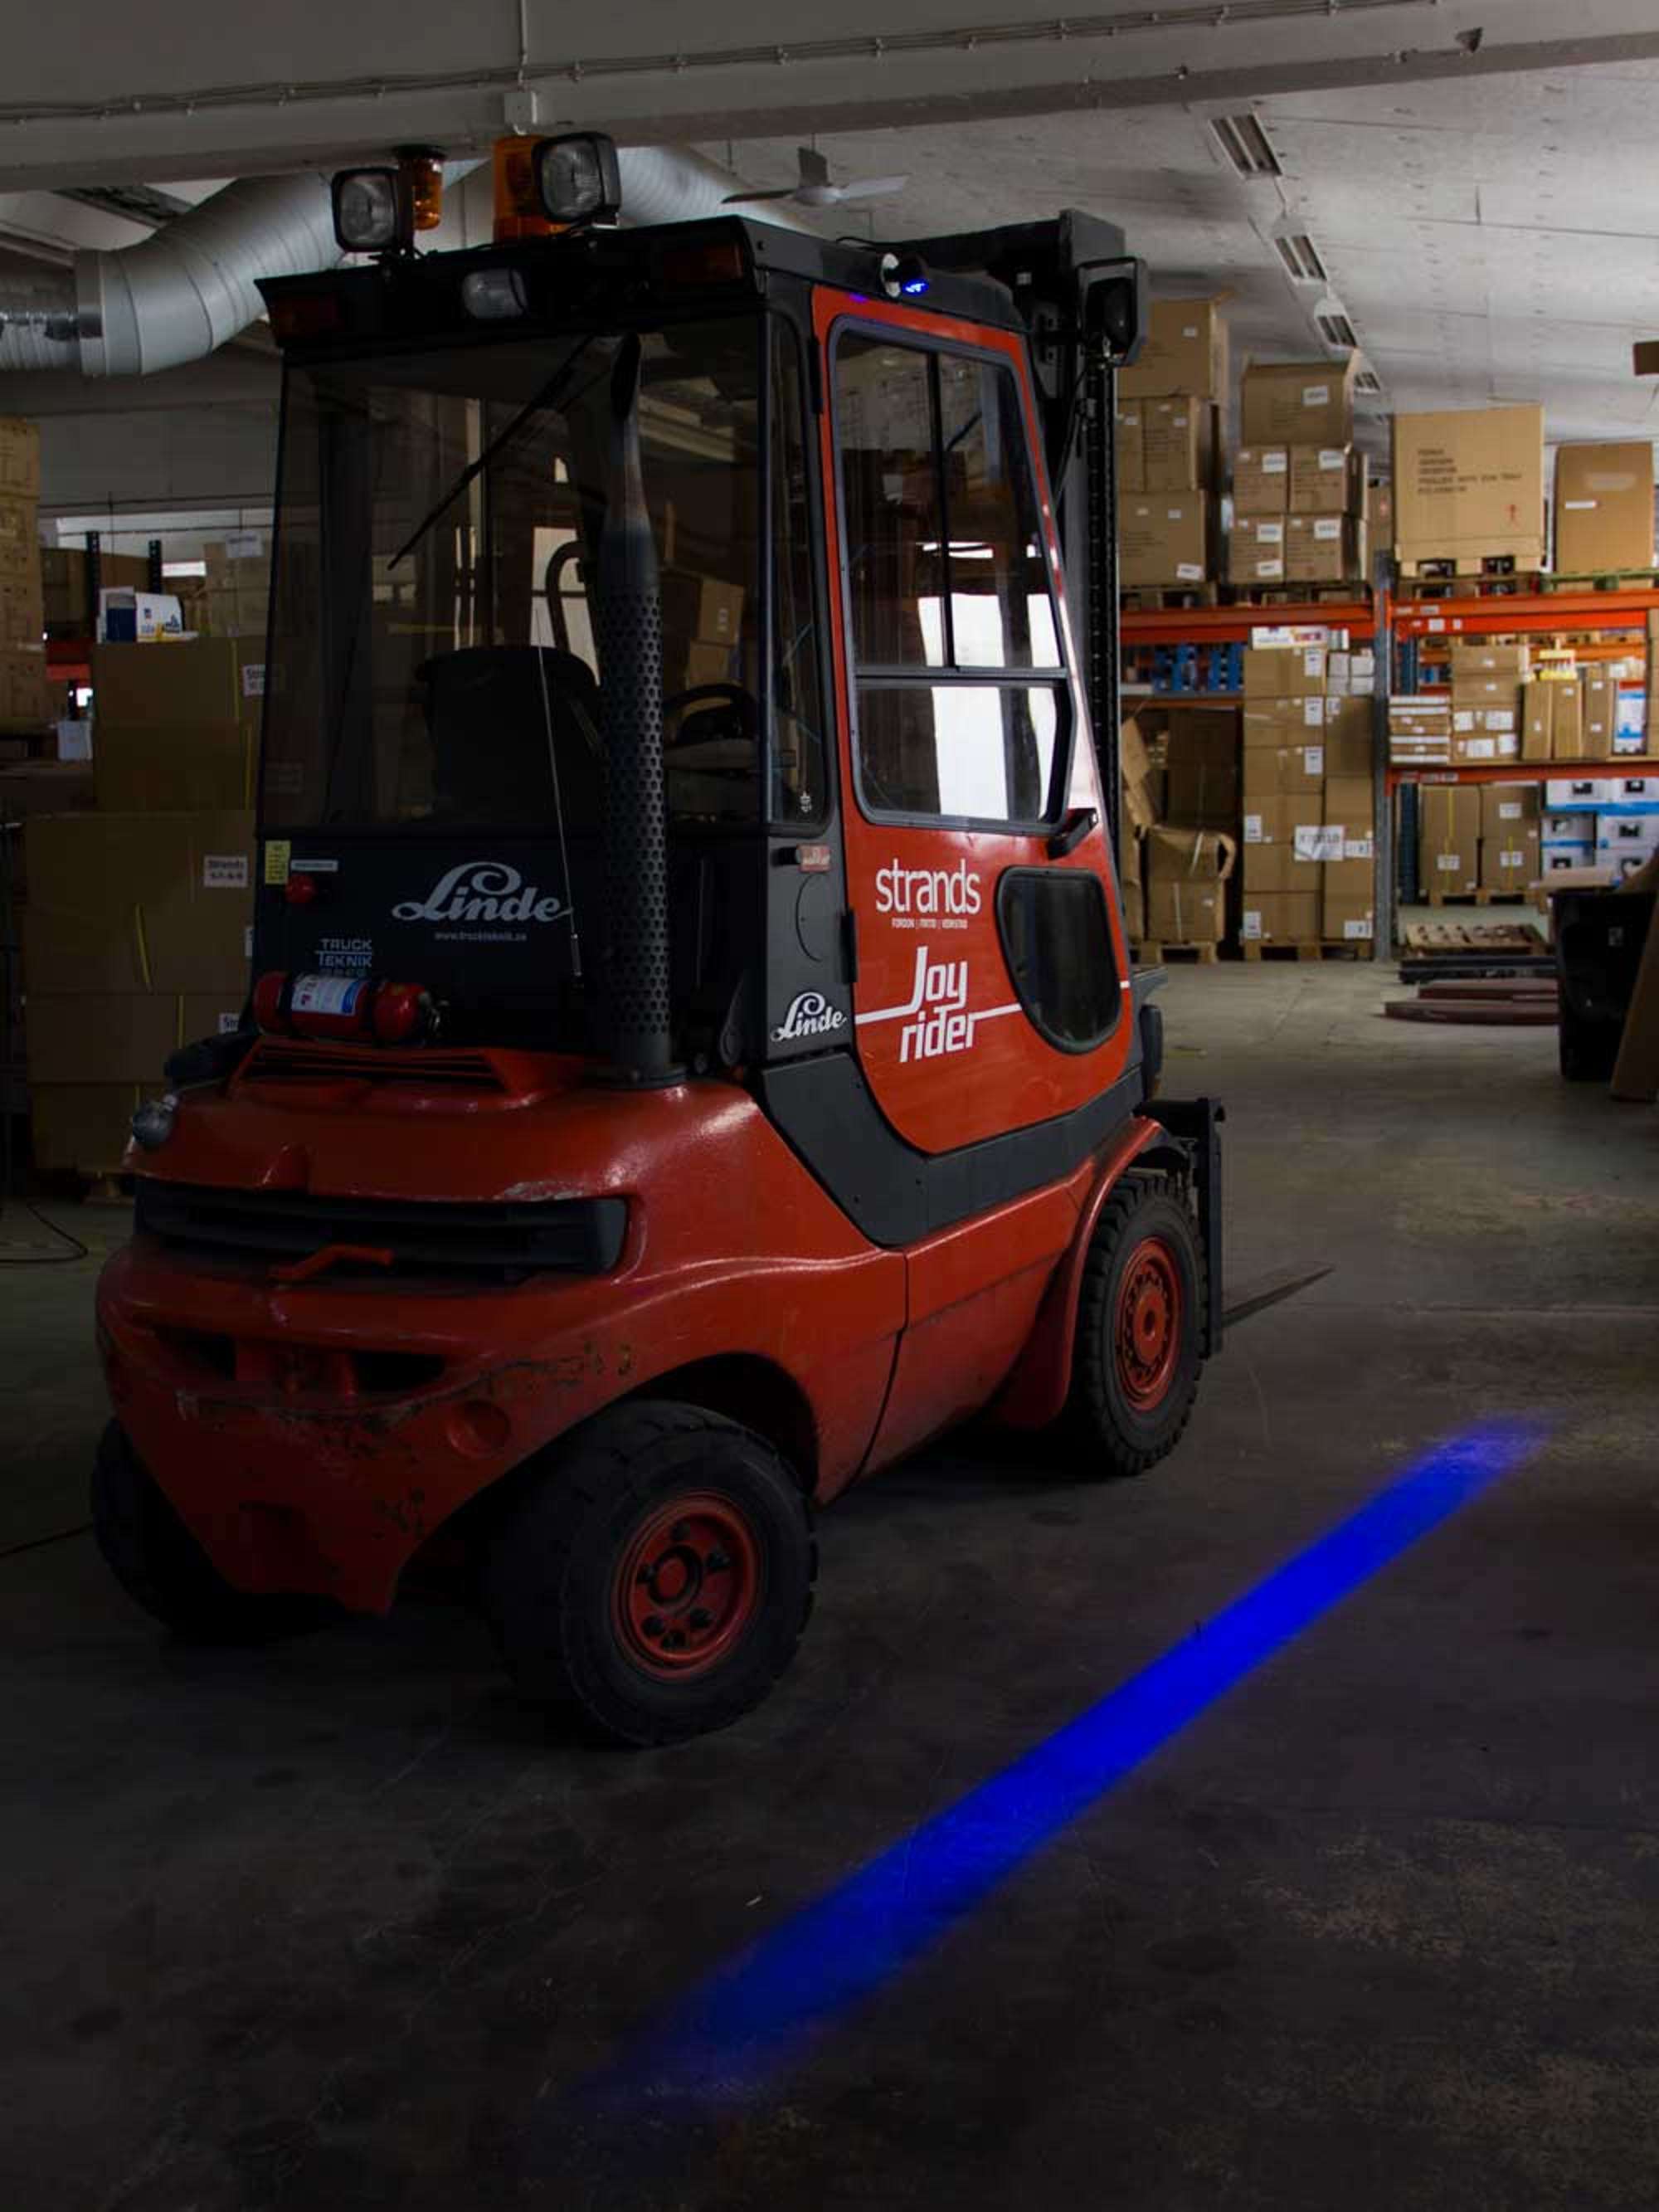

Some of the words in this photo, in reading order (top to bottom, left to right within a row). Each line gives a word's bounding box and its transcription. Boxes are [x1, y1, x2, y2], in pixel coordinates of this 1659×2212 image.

[391, 860, 574, 923] Linde
[875, 858, 981, 914] strands
[318, 950, 372, 968] TEKNIK
[320, 938, 372, 950] TRUCK
[907, 945, 968, 1014] Joy
[770, 991, 848, 1042] Linde
[899, 1008, 977, 1063] rider
